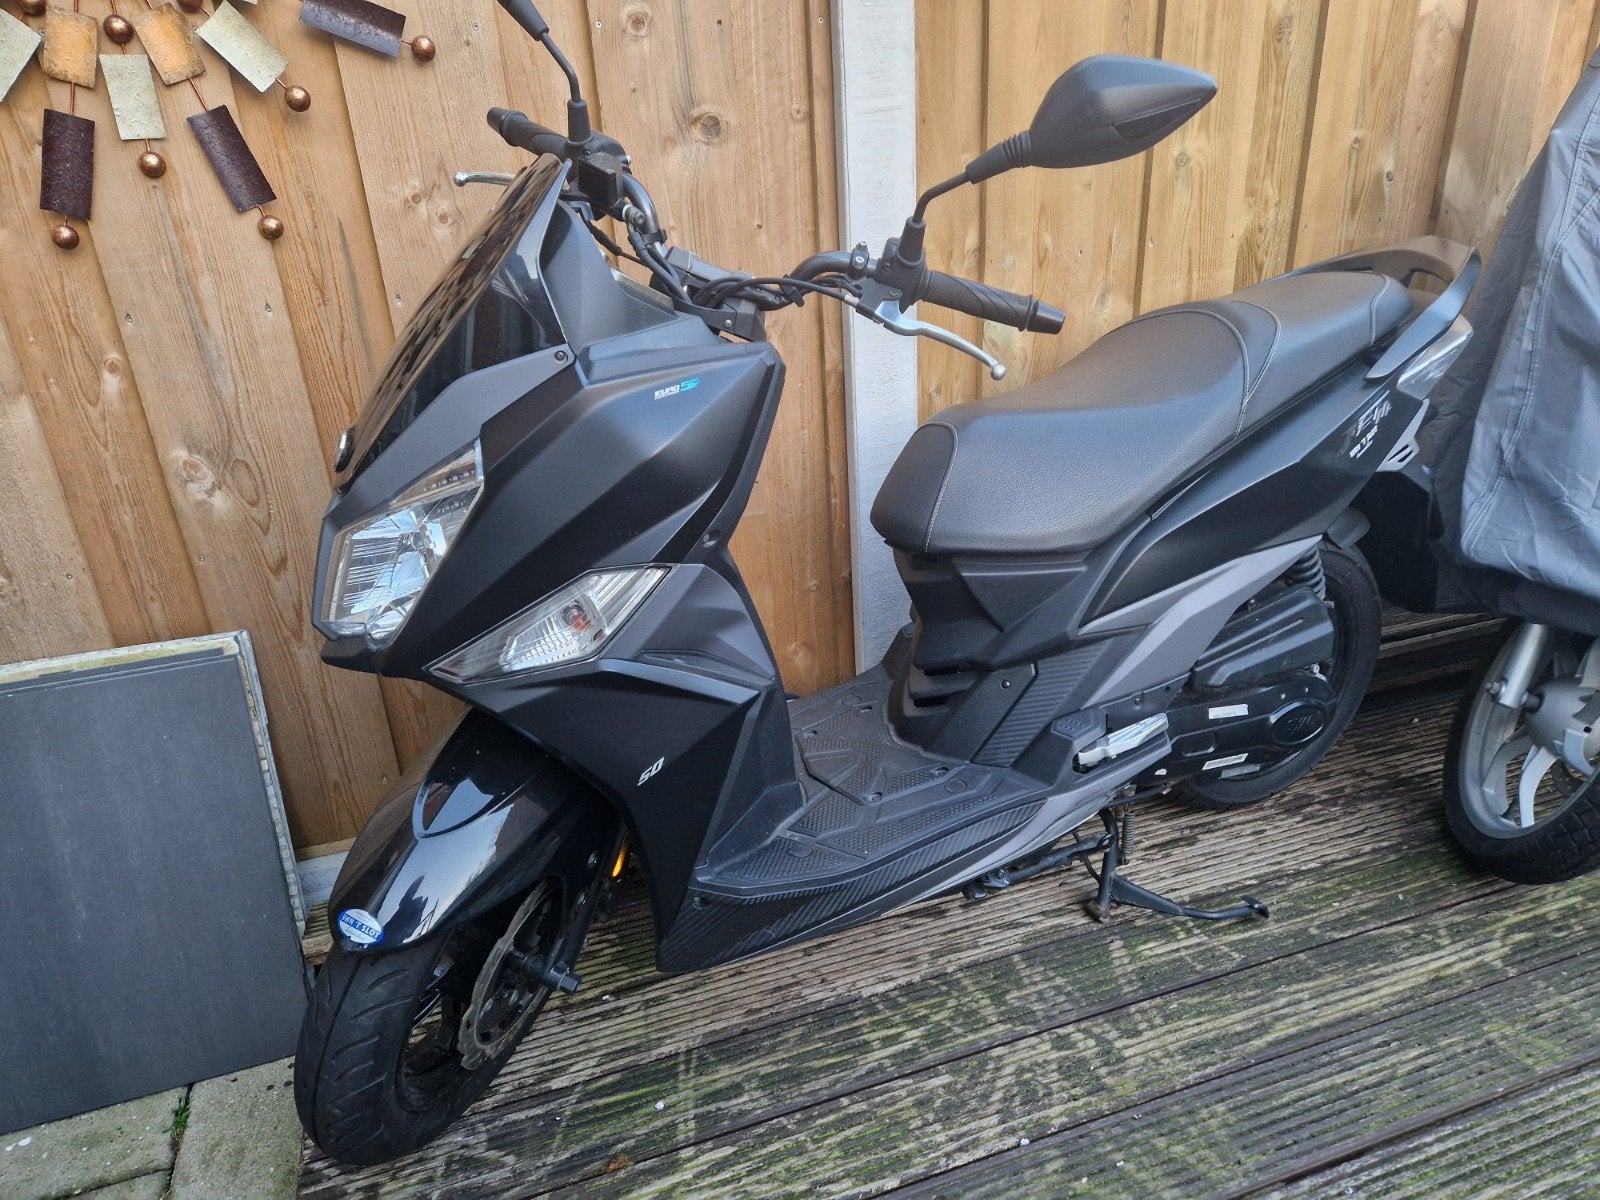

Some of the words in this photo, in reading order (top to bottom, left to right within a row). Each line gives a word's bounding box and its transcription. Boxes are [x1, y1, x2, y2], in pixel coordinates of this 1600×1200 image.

[654, 384, 680, 397] EURO
[638, 757, 665, 786] 50
[360, 924, 382, 939] SLOT
